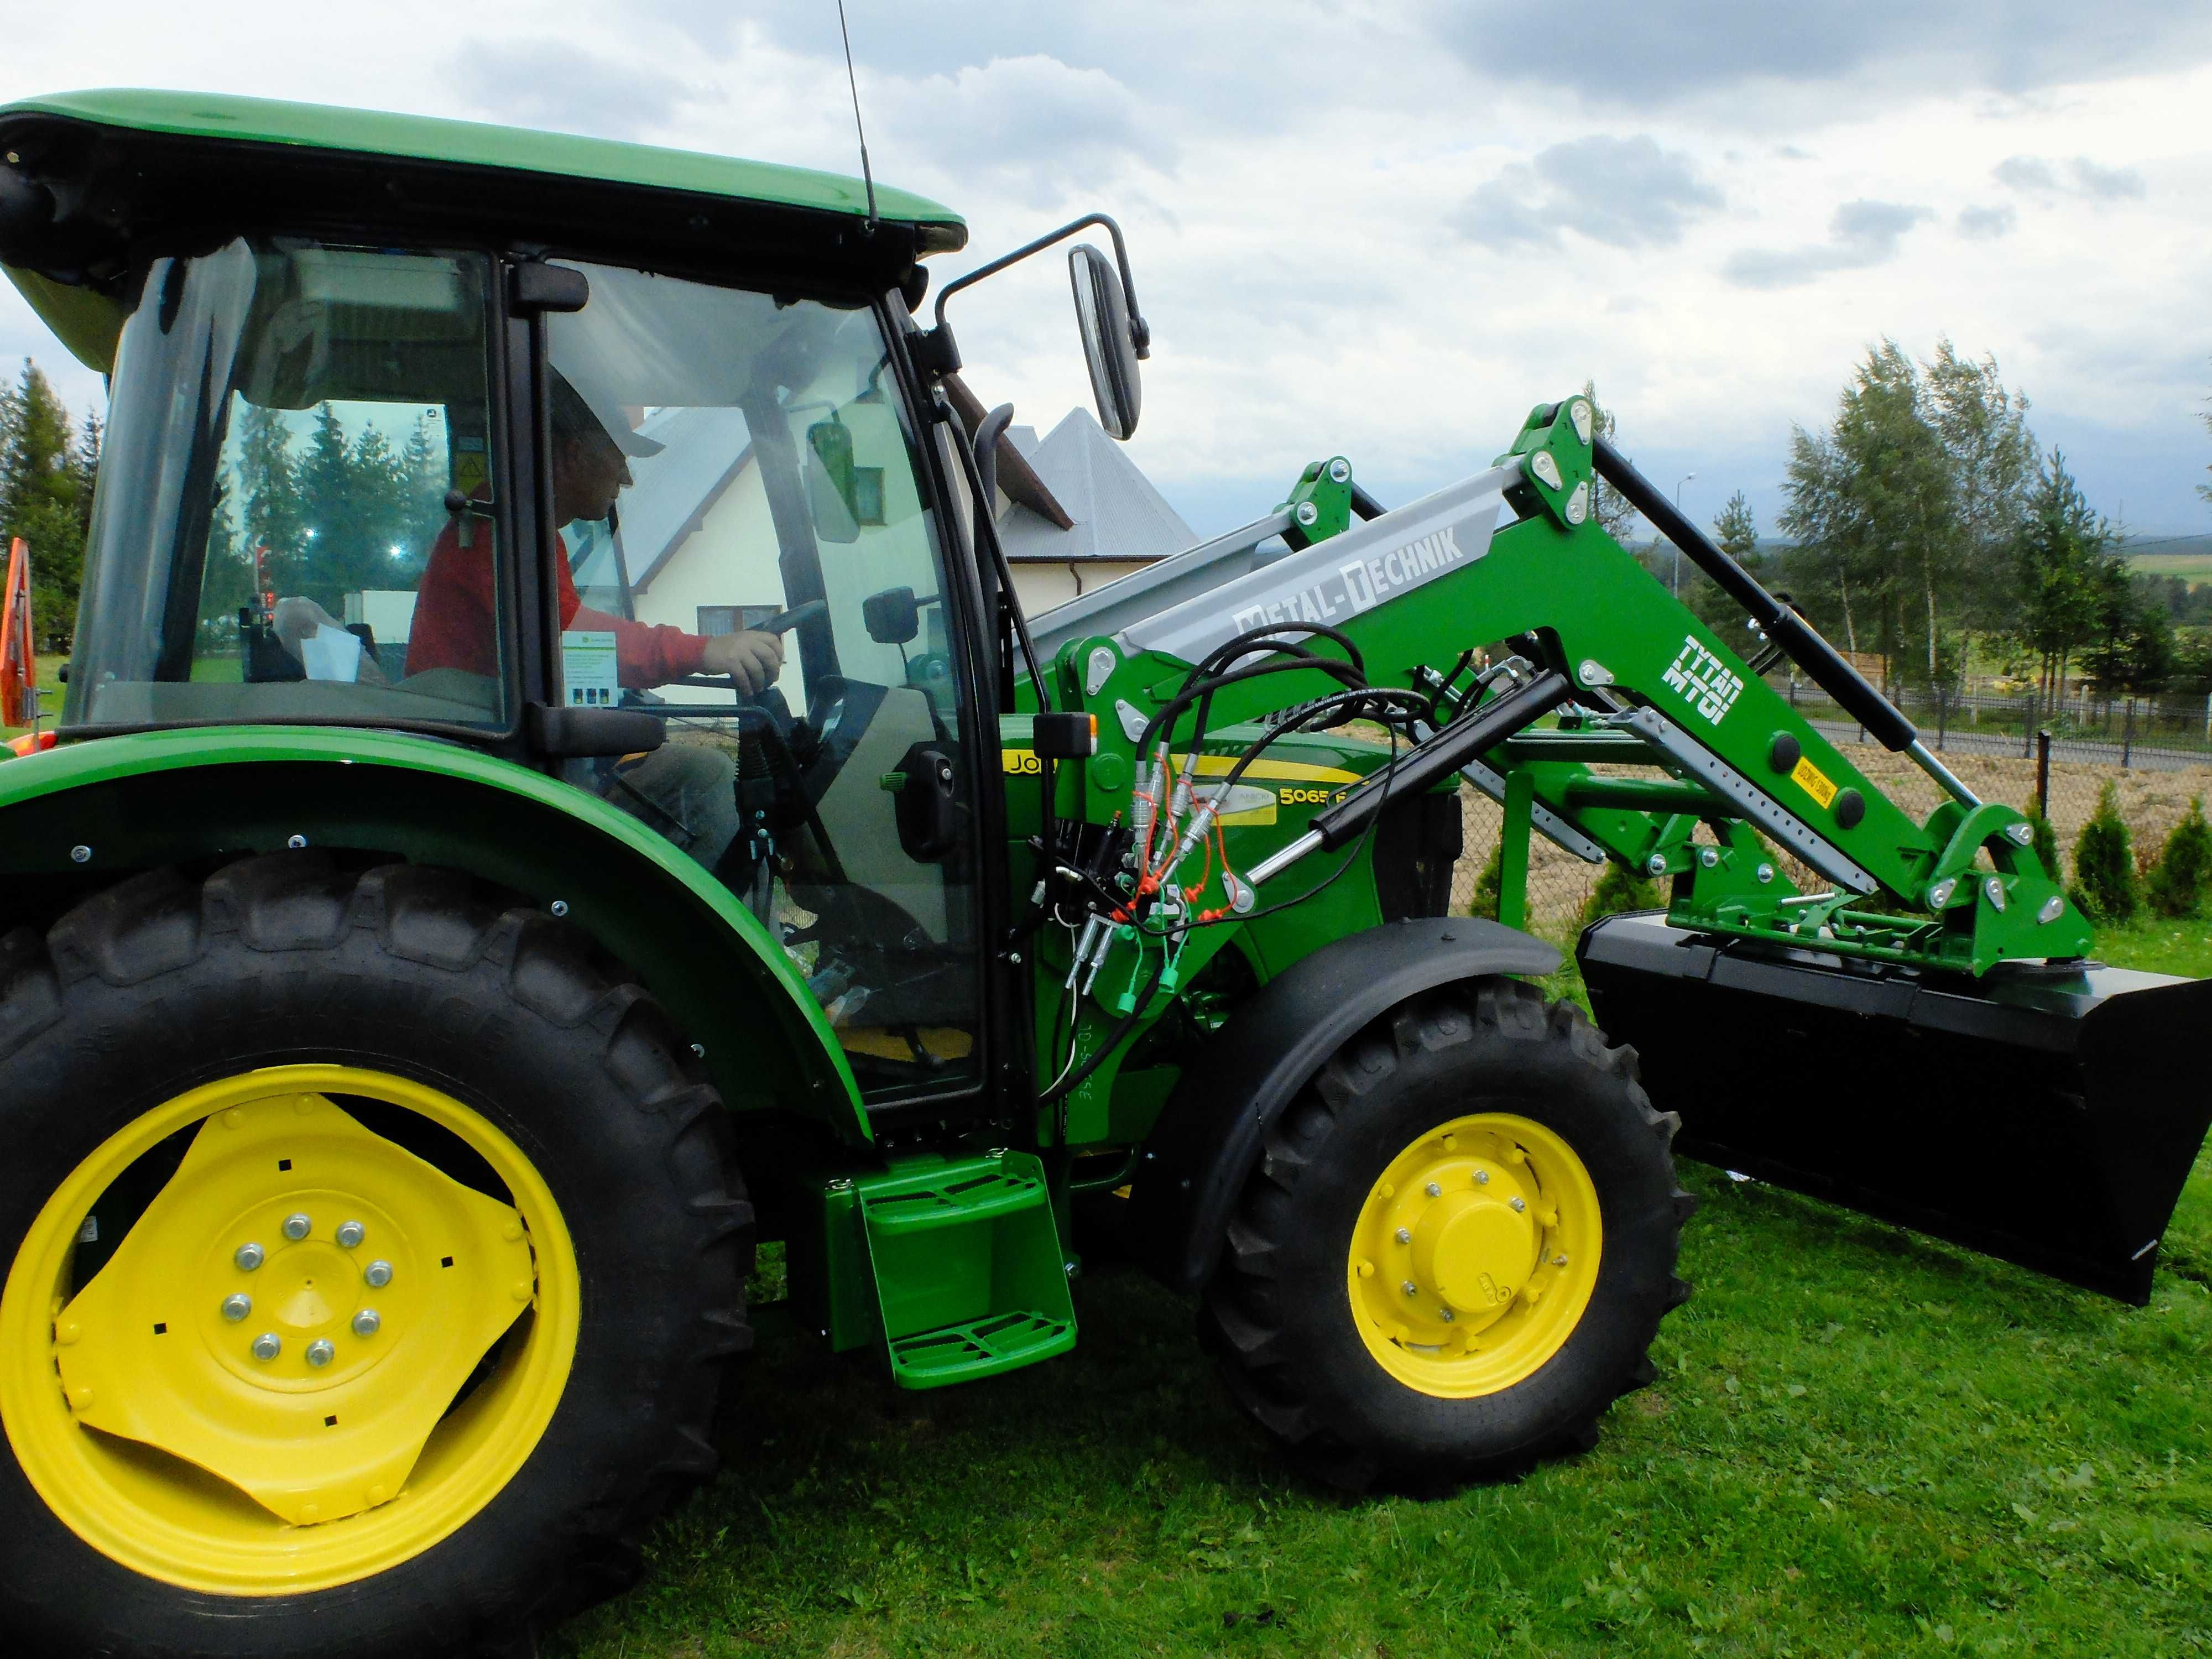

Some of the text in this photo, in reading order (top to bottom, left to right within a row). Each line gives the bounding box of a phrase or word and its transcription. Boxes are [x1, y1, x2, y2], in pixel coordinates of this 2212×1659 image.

[1232, 526, 1464, 660] METAL-TECHNIK
[1679, 634, 1744, 704] TYTAN
[1279, 788, 1329, 805] 5065
